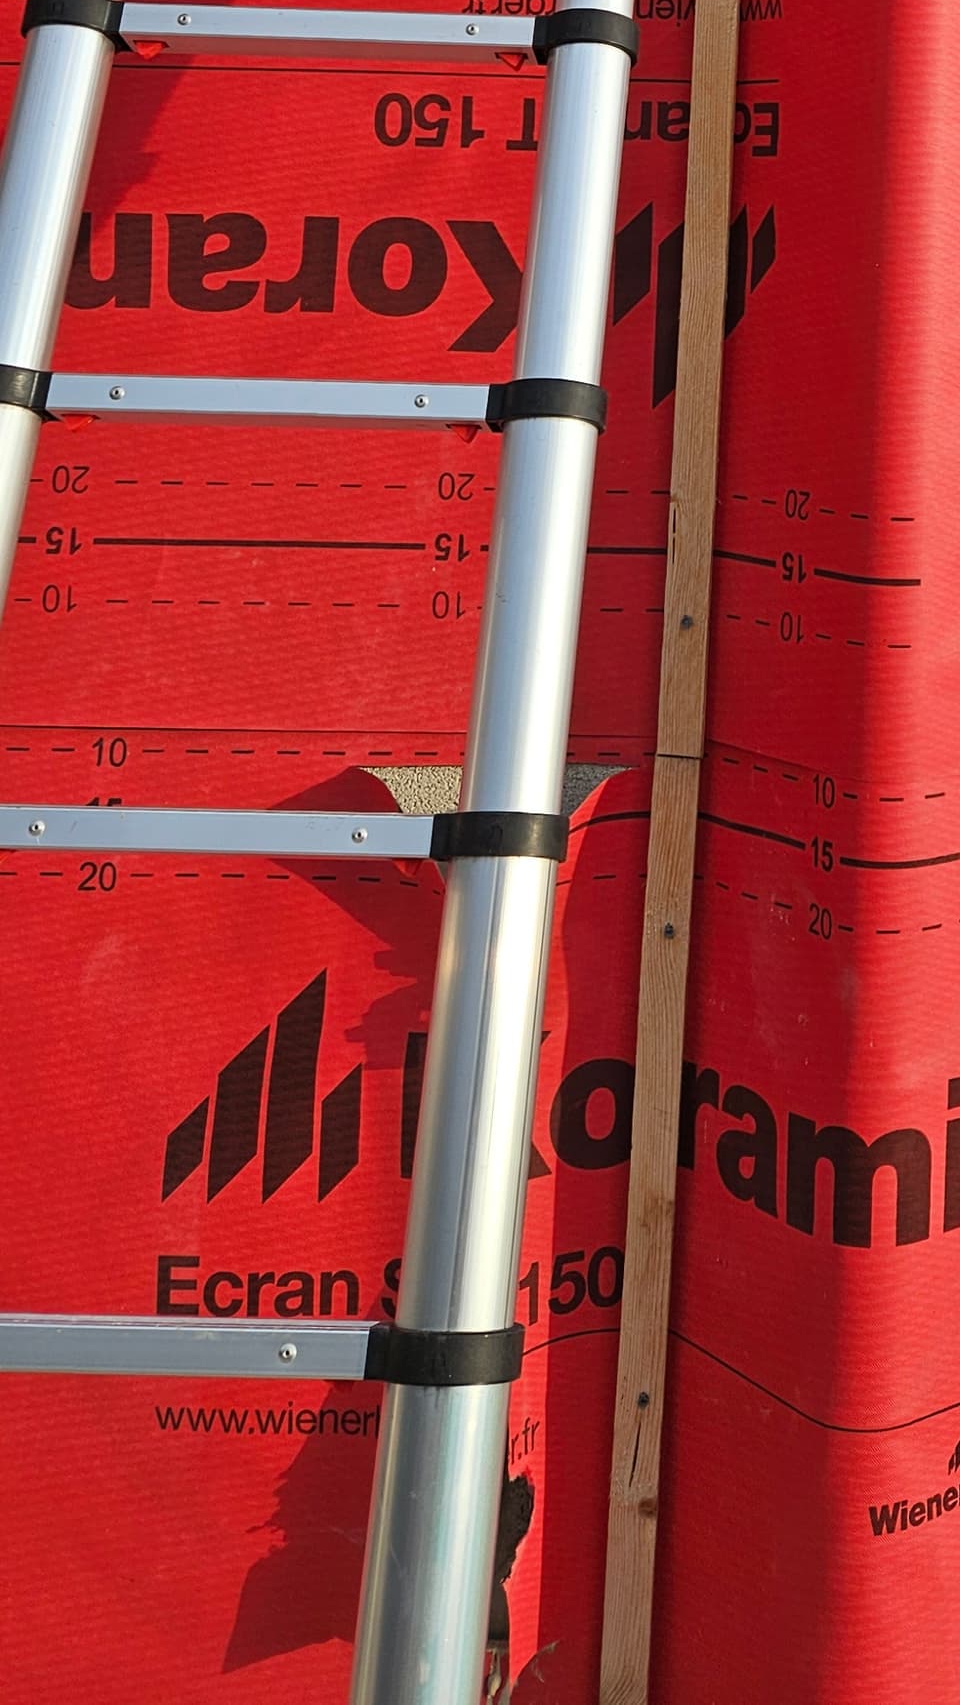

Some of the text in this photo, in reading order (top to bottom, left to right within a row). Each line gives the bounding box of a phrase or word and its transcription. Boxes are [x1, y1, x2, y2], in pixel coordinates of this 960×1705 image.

[374, 92, 485, 149] 150
[624, 101, 780, 157] Ecan
[51, 465, 90, 493] 20
[437, 472, 475, 501] 20
[785, 488, 811, 521] 20
[45, 526, 83, 556] 15
[433, 532, 470, 562] 15
[781, 551, 807, 584] 15
[41, 584, 79, 614] 10
[431, 590, 467, 620] 10
[780, 611, 804, 644] 10
[92, 737, 128, 768] 10
[812, 773, 836, 809] 10
[810, 839, 834, 873] 15
[77, 861, 118, 892] 20
[808, 903, 833, 940] 20
[156, 1255, 360, 1318] Ecran
[519, 1246, 626, 1327] 150
